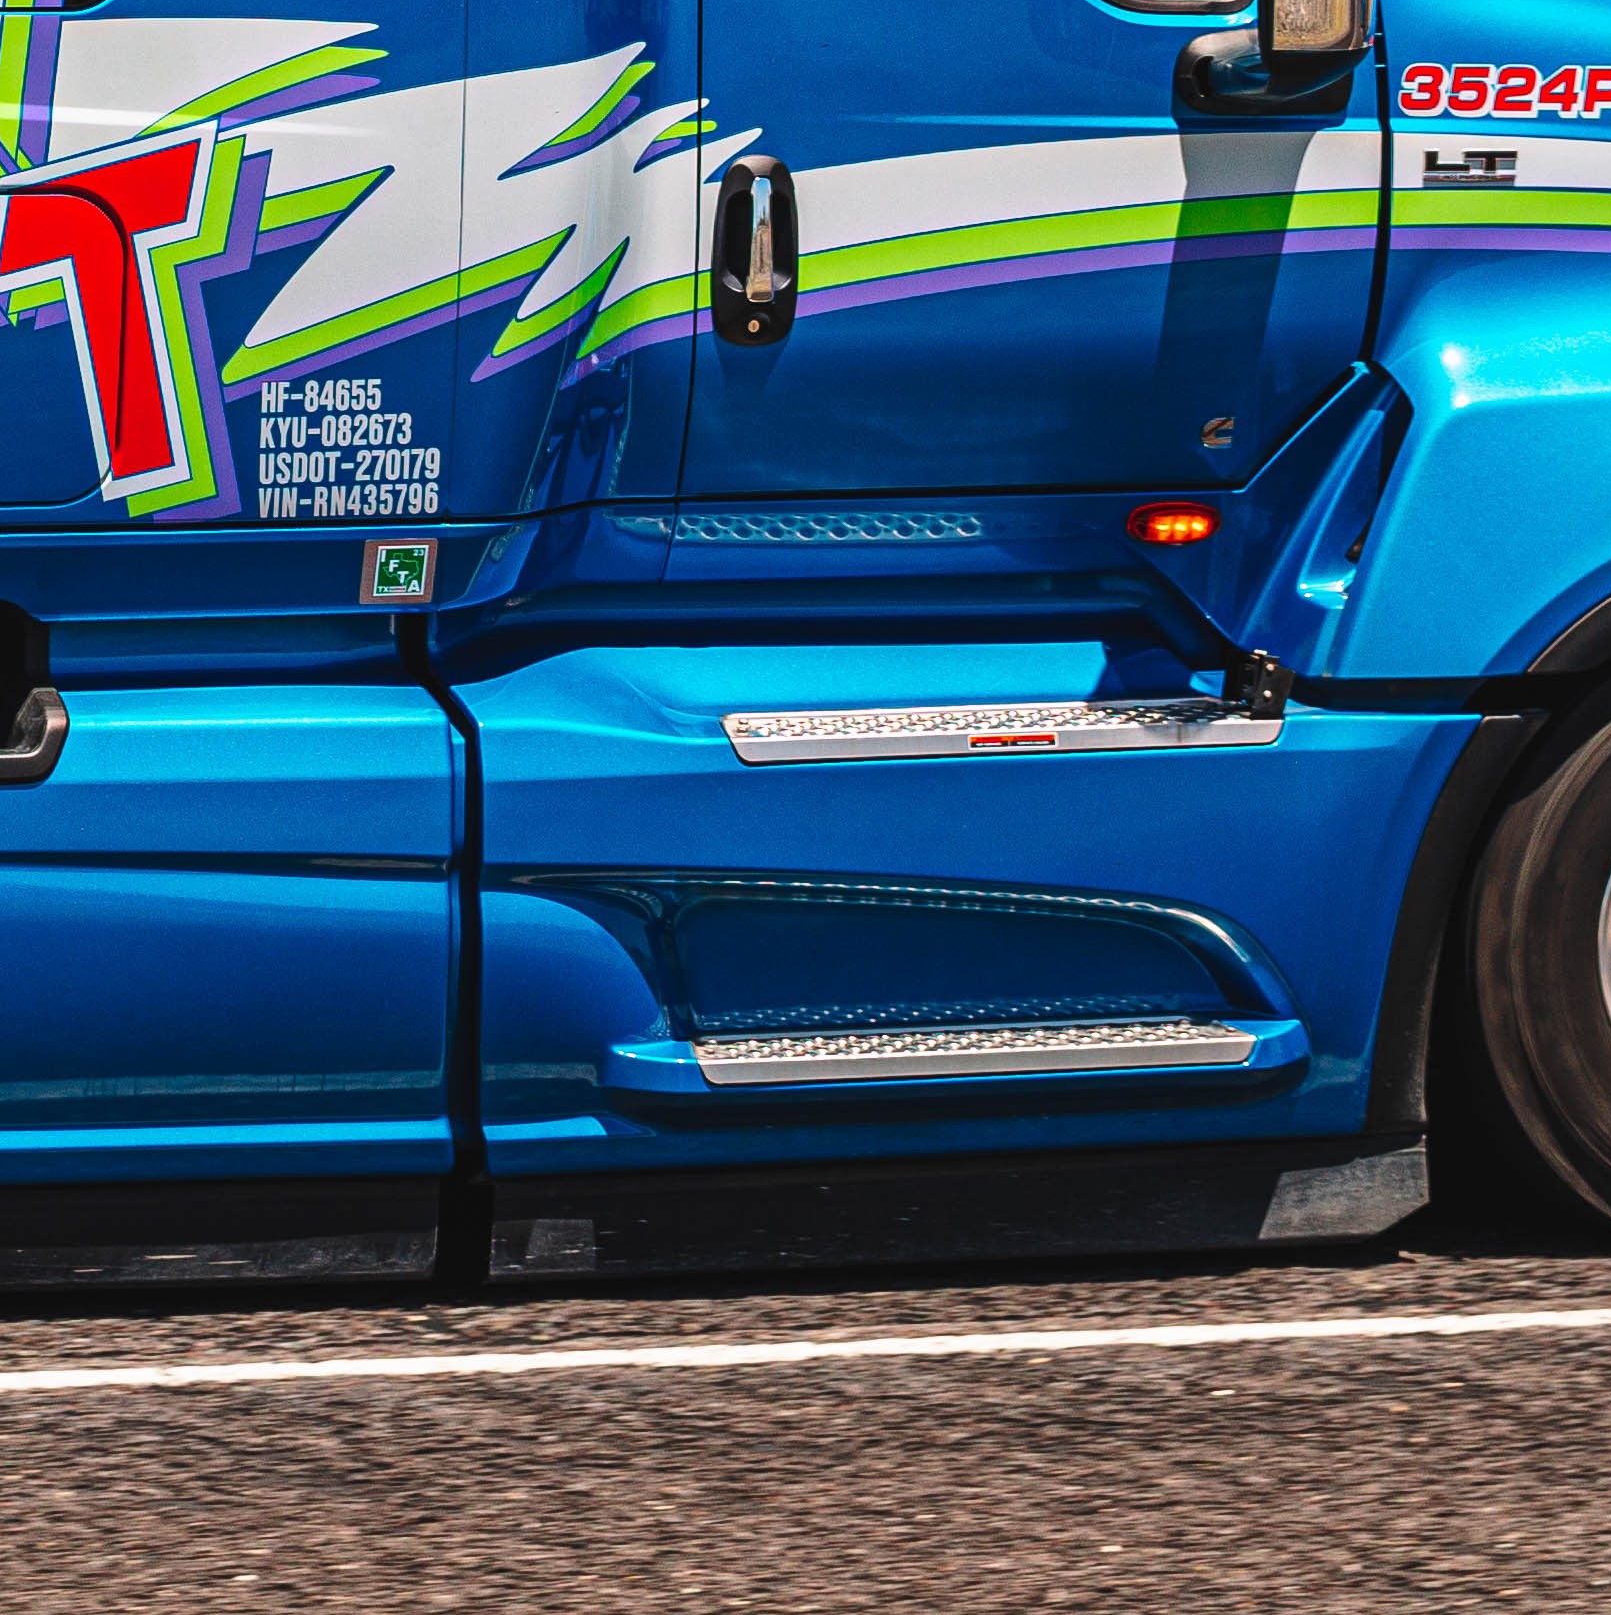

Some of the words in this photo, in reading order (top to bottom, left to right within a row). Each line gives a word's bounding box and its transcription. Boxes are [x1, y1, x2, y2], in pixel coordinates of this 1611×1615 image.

[1424, 148, 1518, 173] LT
[260, 378, 382, 414] HF-84655
[259, 413, 413, 449] KYU-082673
[258, 448, 441, 485] USDOT-270179
[258, 483, 439, 518] VIN-RN435796
